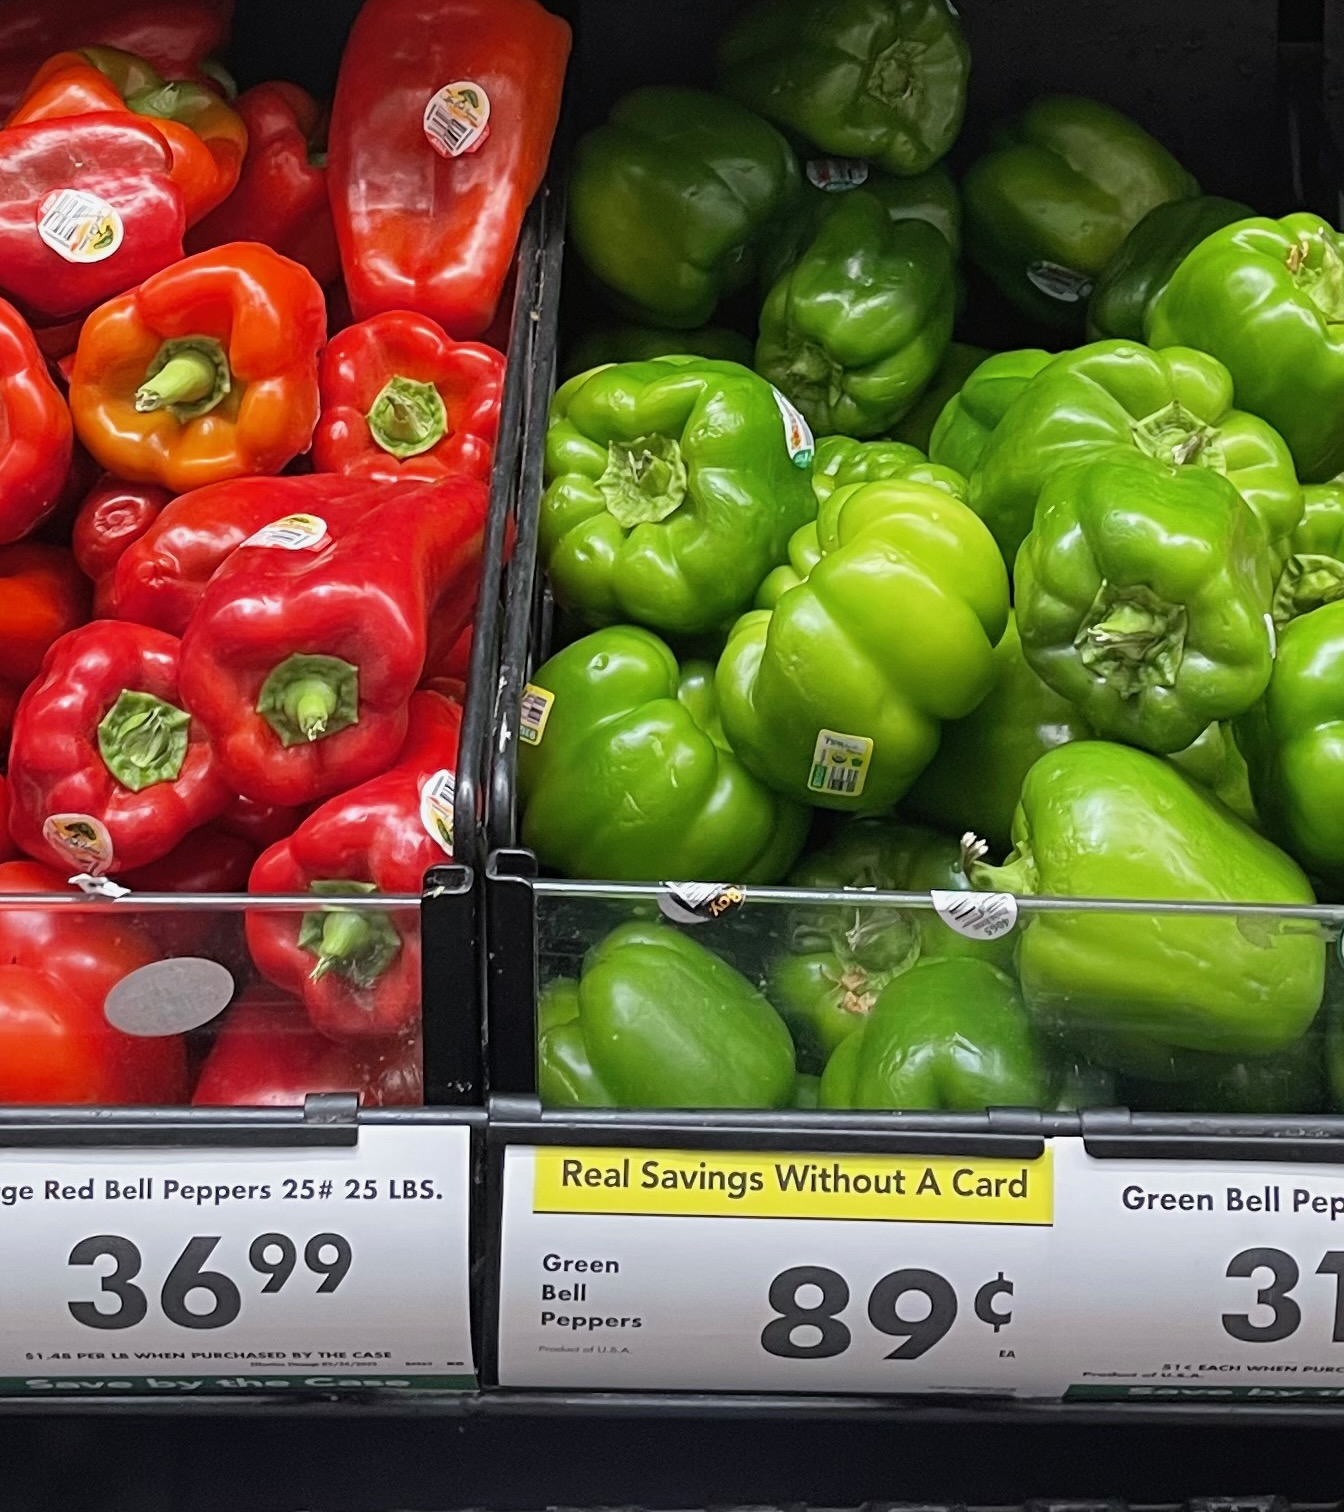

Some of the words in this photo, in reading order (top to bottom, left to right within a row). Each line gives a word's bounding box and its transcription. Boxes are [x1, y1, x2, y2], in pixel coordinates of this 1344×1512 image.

[563, 1159, 629, 1187] Real
[641, 1161, 763, 1199] Savings
[775, 1164, 905, 1194] Without
[916, 1168, 941, 1195] A
[953, 1169, 1027, 1198] Card
[45, 1178, 94, 1199] Red
[106, 1178, 152, 1199] Bell
[164, 1180, 271, 1205] Peppers
[283, 1179, 332, 1199] 25#
[345, 1179, 377, 1199] 25
[390, 1180, 442, 1199] LBS.
[1123, 1186, 1213, 1210] Green
[1227, 1186, 1279, 1212] Bell
[543, 1254, 618, 1273] Green
[542, 1283, 585, 1301] Bell
[542, 1312, 641, 1331] Peppers
[761, 1266, 1016, 1360] 89¢
[78, 1352, 106, 1360] PER
[999, 1350, 1015, 1358] EA
[1198, 1364, 1241, 1372] EACH
[1248, 1364, 1298, 1372] WHEN
